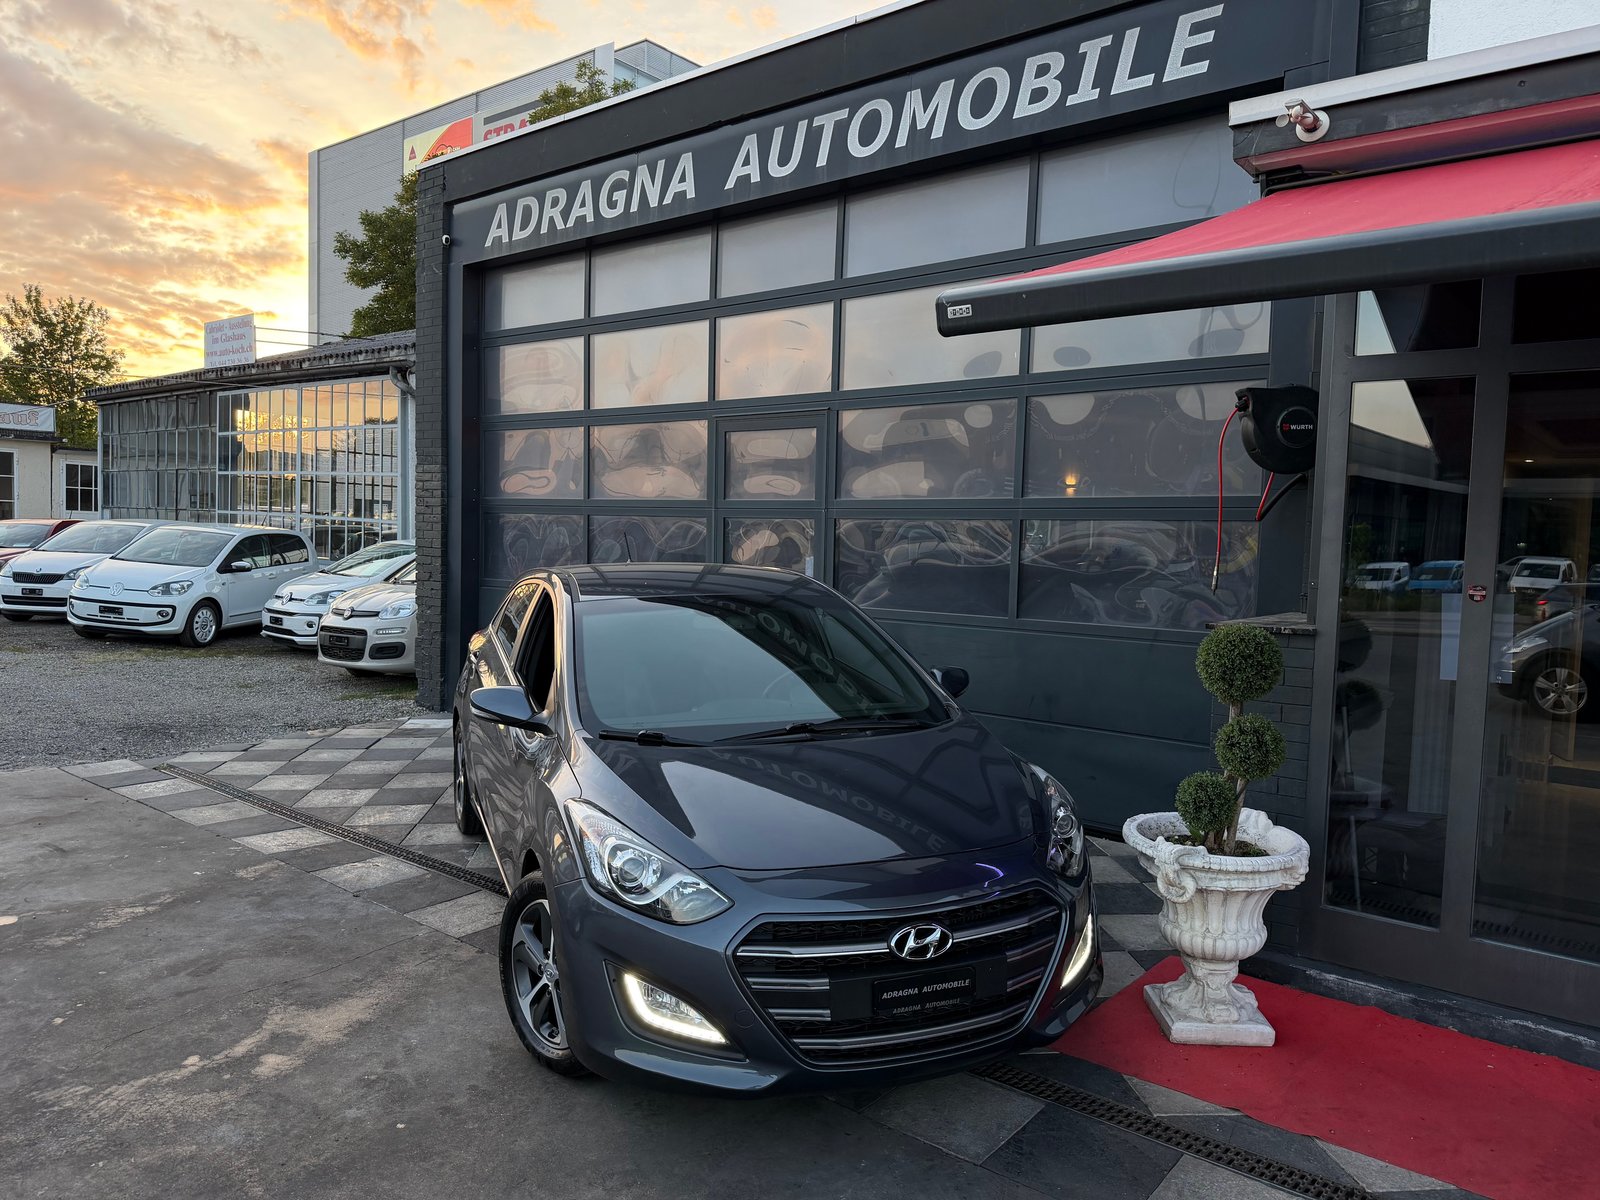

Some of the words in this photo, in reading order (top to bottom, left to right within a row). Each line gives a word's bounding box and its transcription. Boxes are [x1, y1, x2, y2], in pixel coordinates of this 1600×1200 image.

[484, 152, 696, 247] ADRAGNA
[724, 3, 1224, 191] AUTOMOBILE
[882, 987, 918, 999] ADRAGNA
[922, 979, 970, 993] AUTOMOBILE
